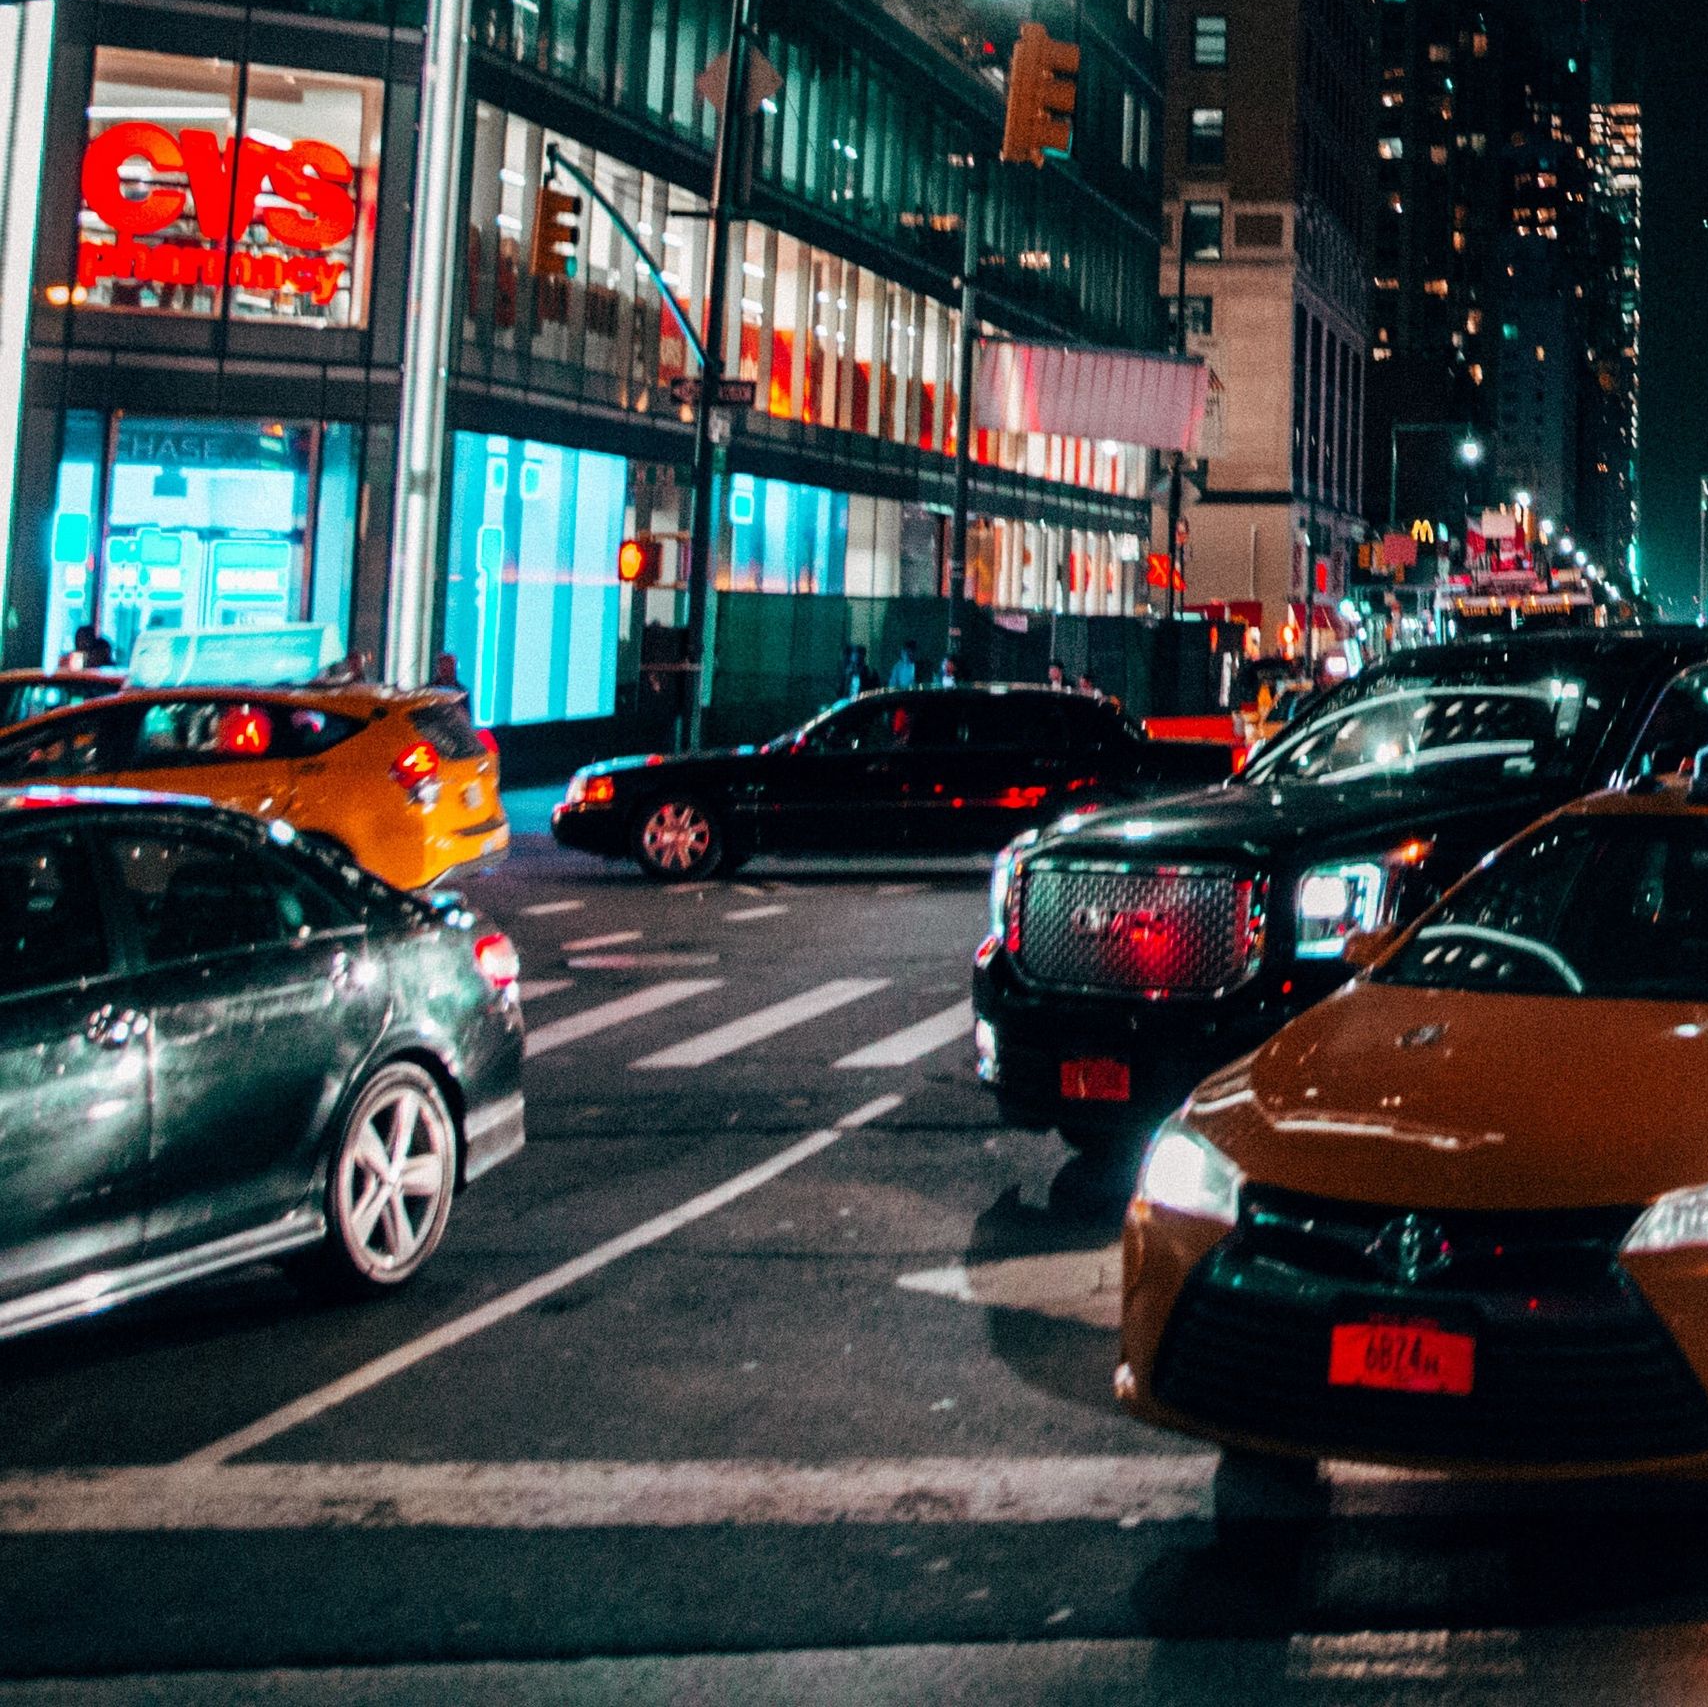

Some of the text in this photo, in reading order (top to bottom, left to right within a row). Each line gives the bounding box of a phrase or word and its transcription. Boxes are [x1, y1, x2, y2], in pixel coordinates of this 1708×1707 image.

[82, 121, 354, 249] CVS
[79, 232, 345, 305] pharmacy
[119, 433, 222, 460] HASE
